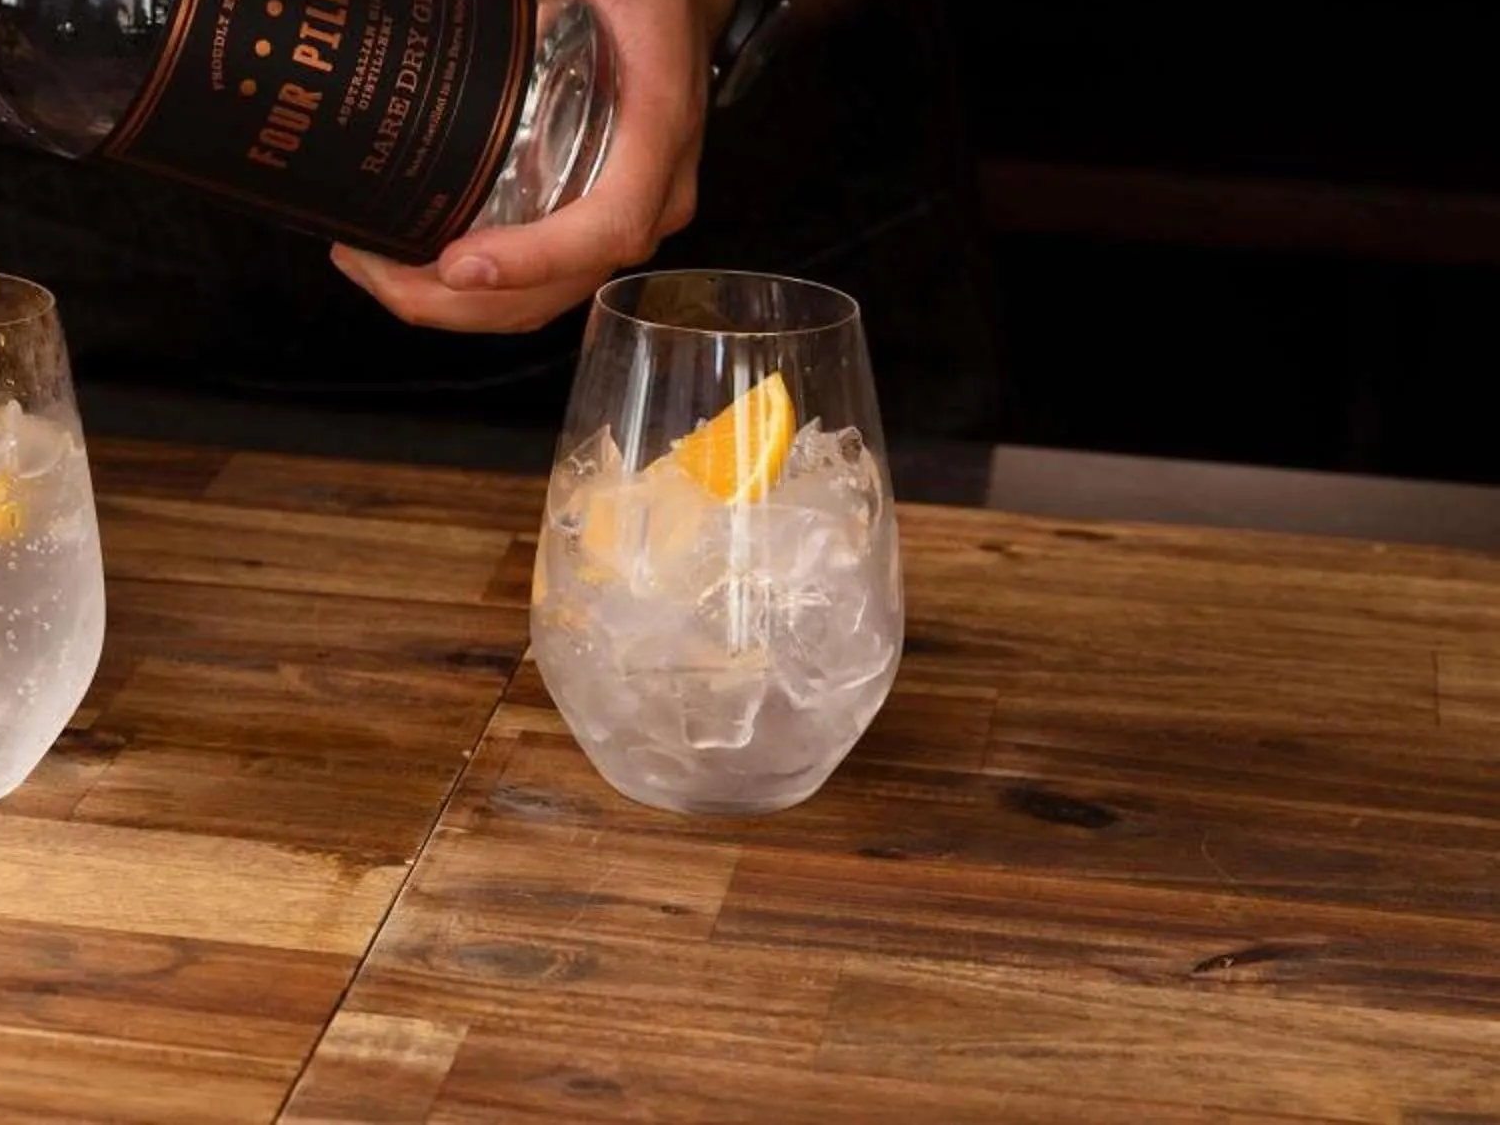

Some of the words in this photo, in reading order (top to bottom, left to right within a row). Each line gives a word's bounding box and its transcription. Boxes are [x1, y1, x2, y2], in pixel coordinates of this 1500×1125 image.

[247, 81, 323, 170] FOUR
[361, 95, 412, 174] RARE
[395, 25, 429, 94] DRY
